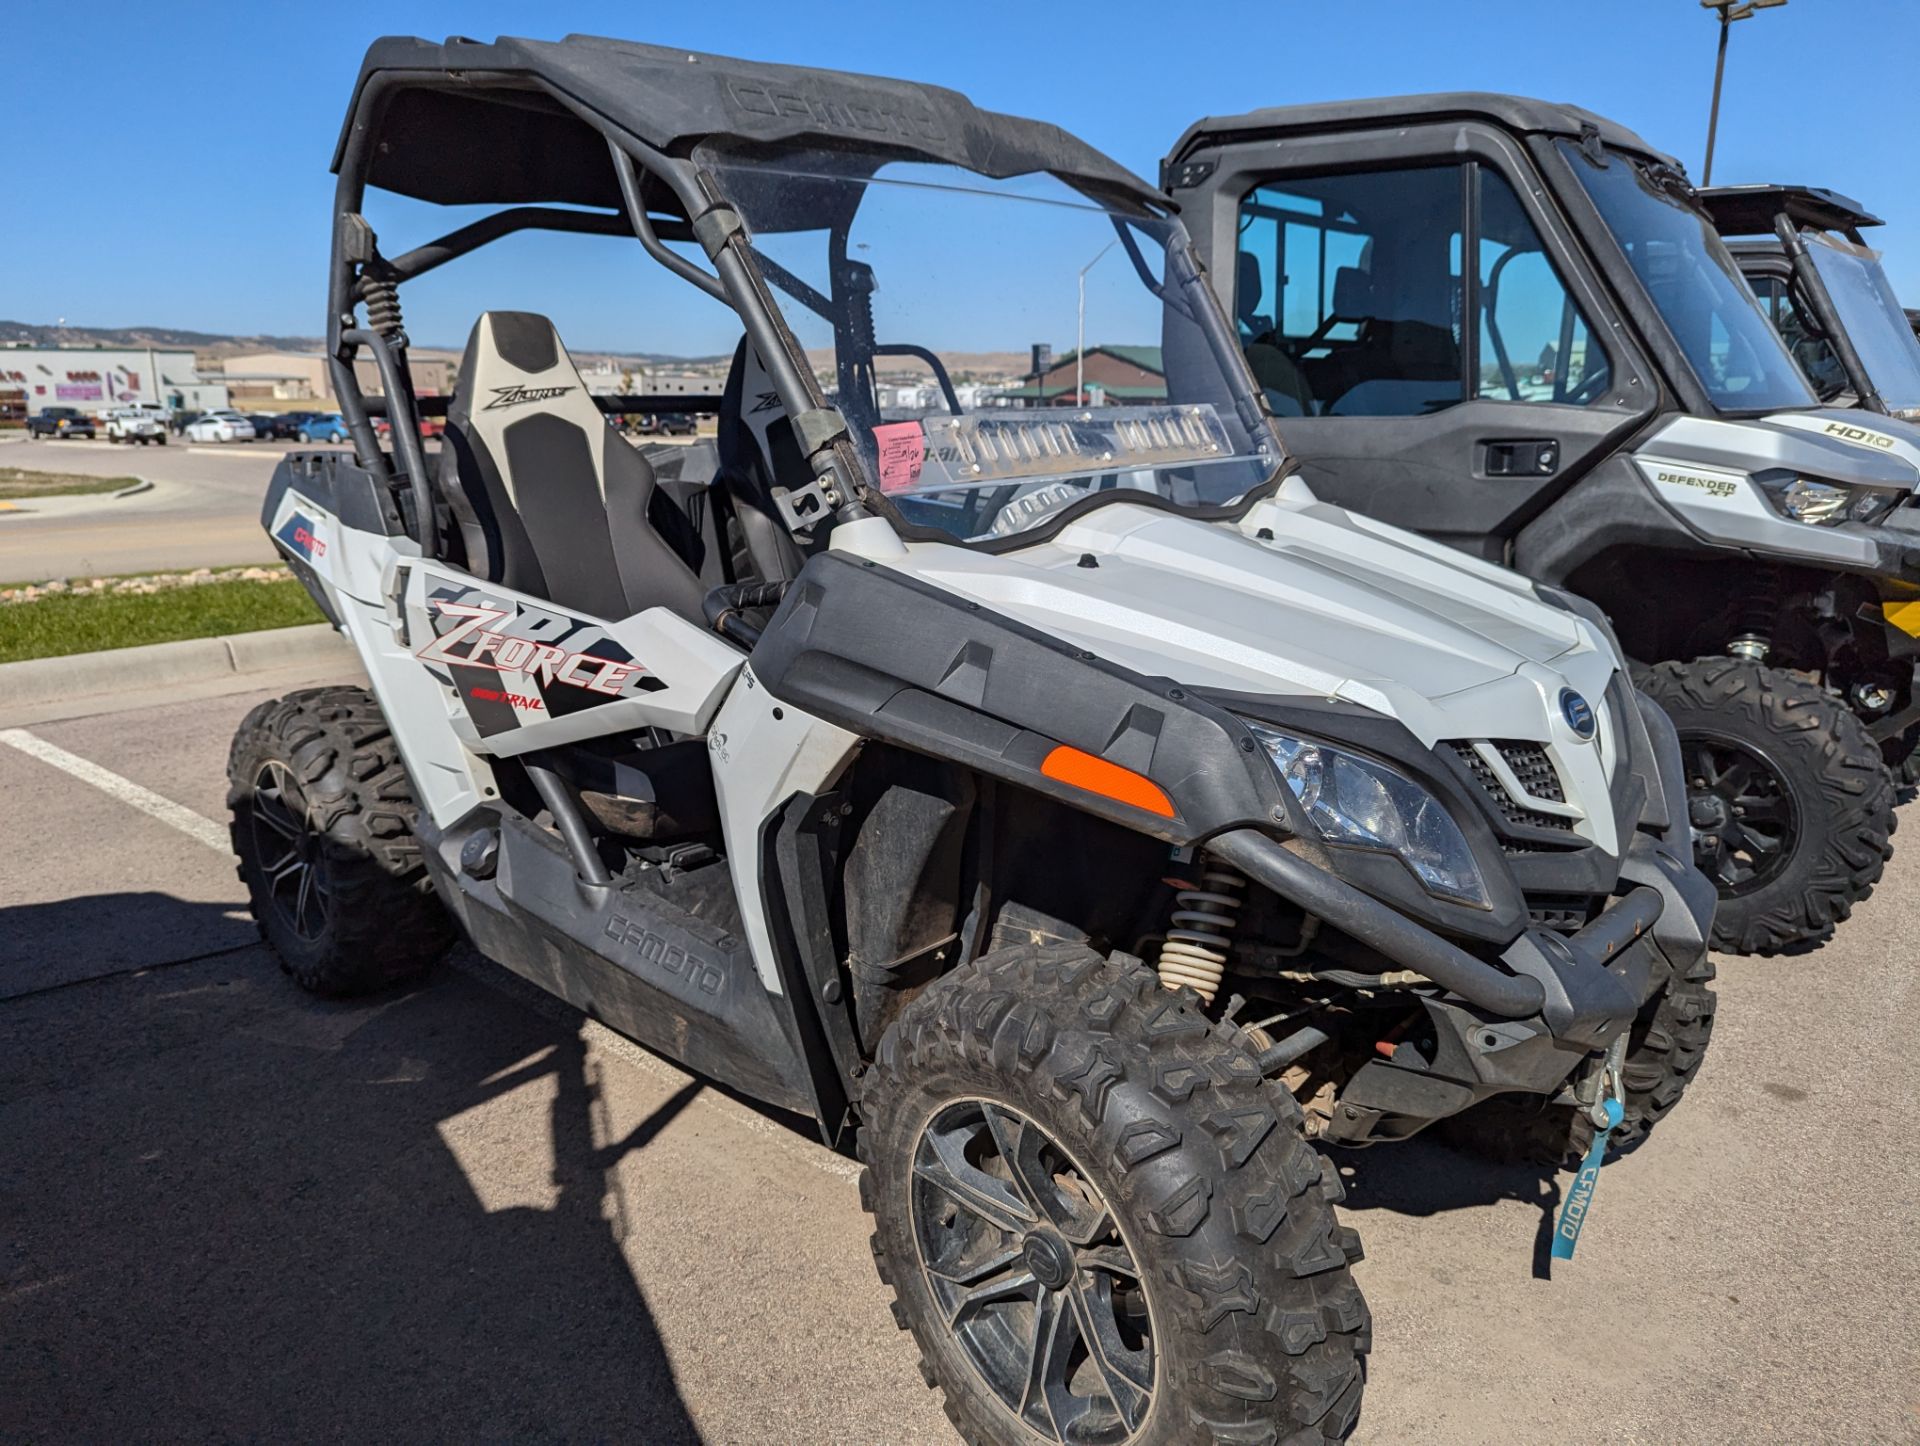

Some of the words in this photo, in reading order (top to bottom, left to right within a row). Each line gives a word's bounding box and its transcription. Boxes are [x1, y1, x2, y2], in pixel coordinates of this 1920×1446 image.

[1825, 423, 1894, 449] HD10
[1658, 472, 1737, 492] DEFENDER
[1706, 489, 1736, 497] XT
[499, 690, 546, 711] TRAIL
[604, 913, 725, 996] CFMOTO
[1561, 1167, 1598, 1240] CFMOTO
